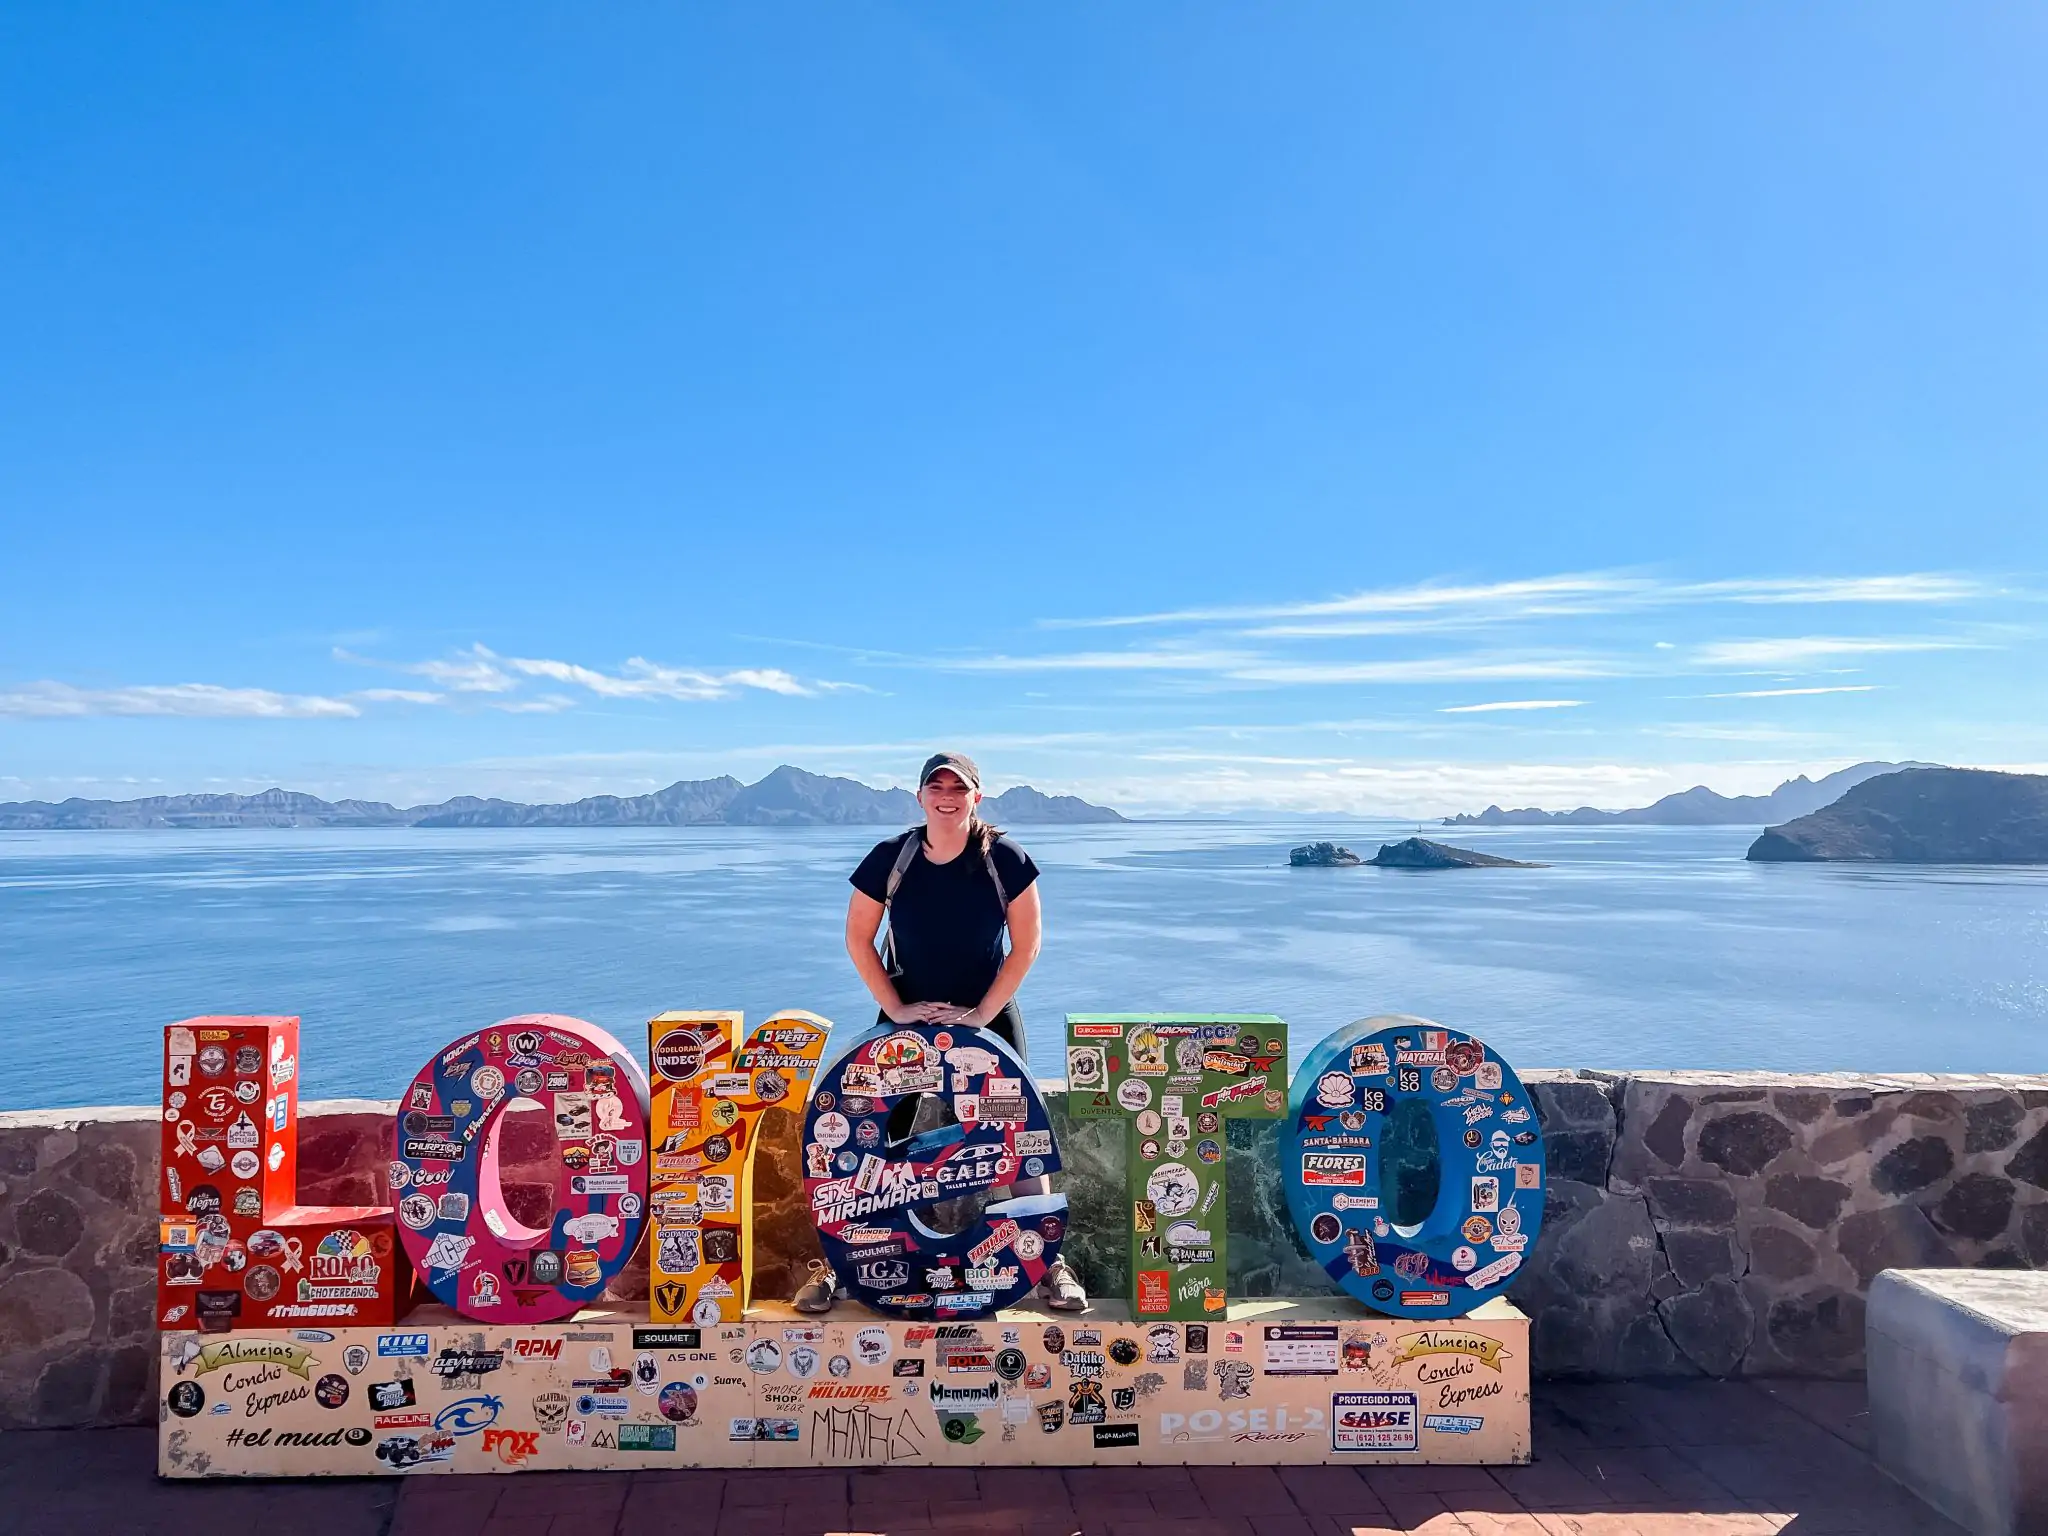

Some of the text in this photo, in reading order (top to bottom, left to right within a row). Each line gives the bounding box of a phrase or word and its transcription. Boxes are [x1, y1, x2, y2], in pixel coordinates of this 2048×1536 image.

[775, 1033, 820, 1042] PEREZ
[756, 1059, 819, 1068] AMADOR
[1364, 1087, 1384, 1101] ke
[1364, 1101, 1384, 1112] so
[1308, 1156, 1362, 1170] FLORES
[936, 1157, 1011, 1184] GABO
[817, 1183, 921, 1227] MIRAMAR
[659, 1230, 698, 1238] RODANDO
[851, 1244, 896, 1259] SOULMET
[1197, 1249, 1214, 1259] JERKY
[311, 1255, 374, 1278] ROMO
[936, 1293, 993, 1307] MACHETES
[380, 1335, 427, 1347] KING
[644, 1334, 689, 1342] SOULMET
[1409, 1332, 1488, 1353] Almejas
[212, 1343, 293, 1364] Almejas
[514, 1339, 563, 1360] RPM
[434, 1356, 474, 1368] CUEVAS
[667, 1352, 717, 1362] AS ONE
[245, 1385, 311, 1418] Express
[765, 1394, 798, 1403] SHOP
[1338, 1396, 1411, 1404] PROTEGIDO POR
[1438, 1381, 1504, 1409] Express
[375, 1415, 430, 1425] RACELINE
[1344, 1411, 1411, 1426] SAYSE
[1425, 1416, 1484, 1429] MACHETES
[226, 1428, 272, 1448] #el
[482, 1429, 541, 1457] FOX
[1356, 1434, 1375, 1443] (612)
